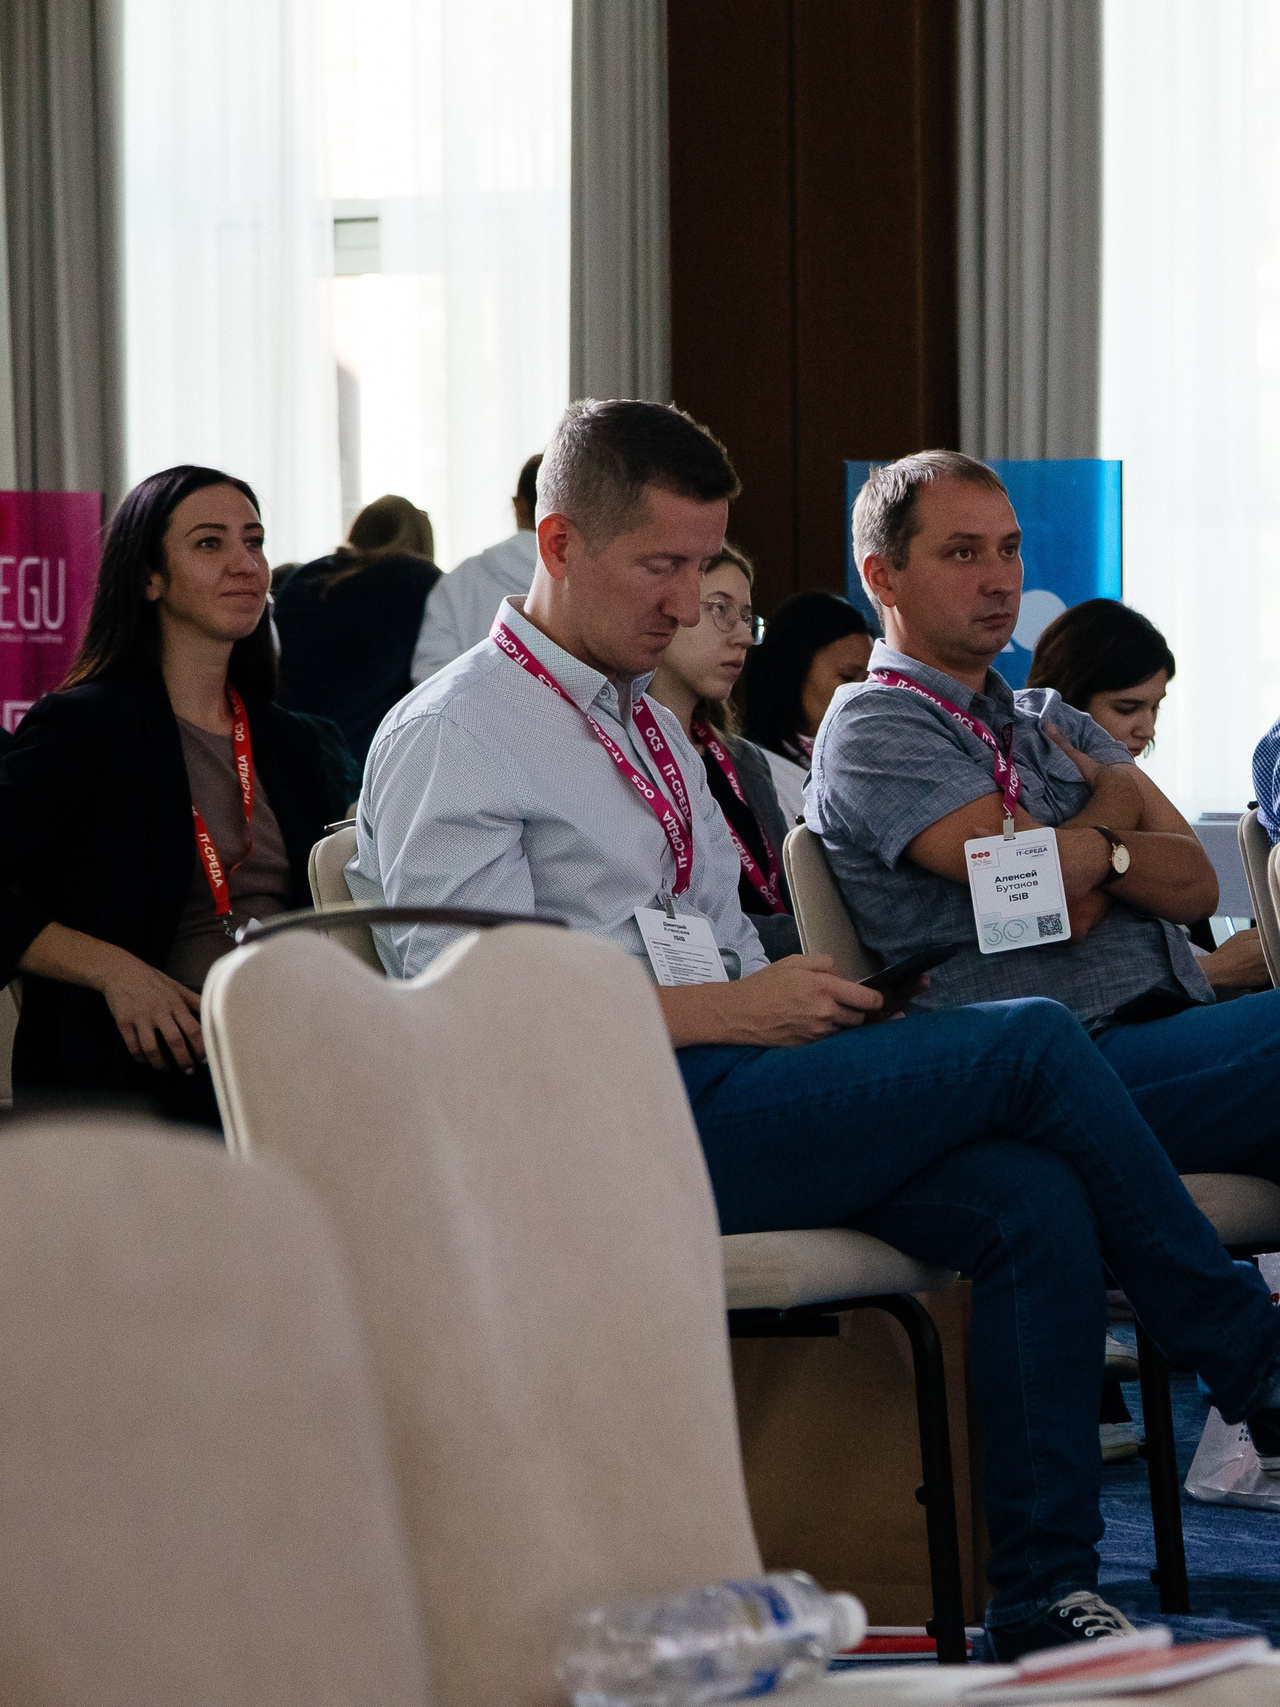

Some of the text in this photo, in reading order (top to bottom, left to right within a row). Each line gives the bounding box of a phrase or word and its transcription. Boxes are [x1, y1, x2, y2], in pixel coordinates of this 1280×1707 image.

[952, 712, 975, 731] OCS
[645, 727, 664, 752] OCS
[631, 774, 655, 799] OCS
[662, 810, 688, 869] IT-СРЕДА
[198, 832, 224, 889] IT-СРЕДА
[1016, 846, 1048, 857] IT-СРЕДА
[994, 869, 1038, 884] Алексей
[996, 880, 1039, 893] Бутаков
[1008, 892, 1029, 903] ISIB
[983, 919, 1029, 946] 30
